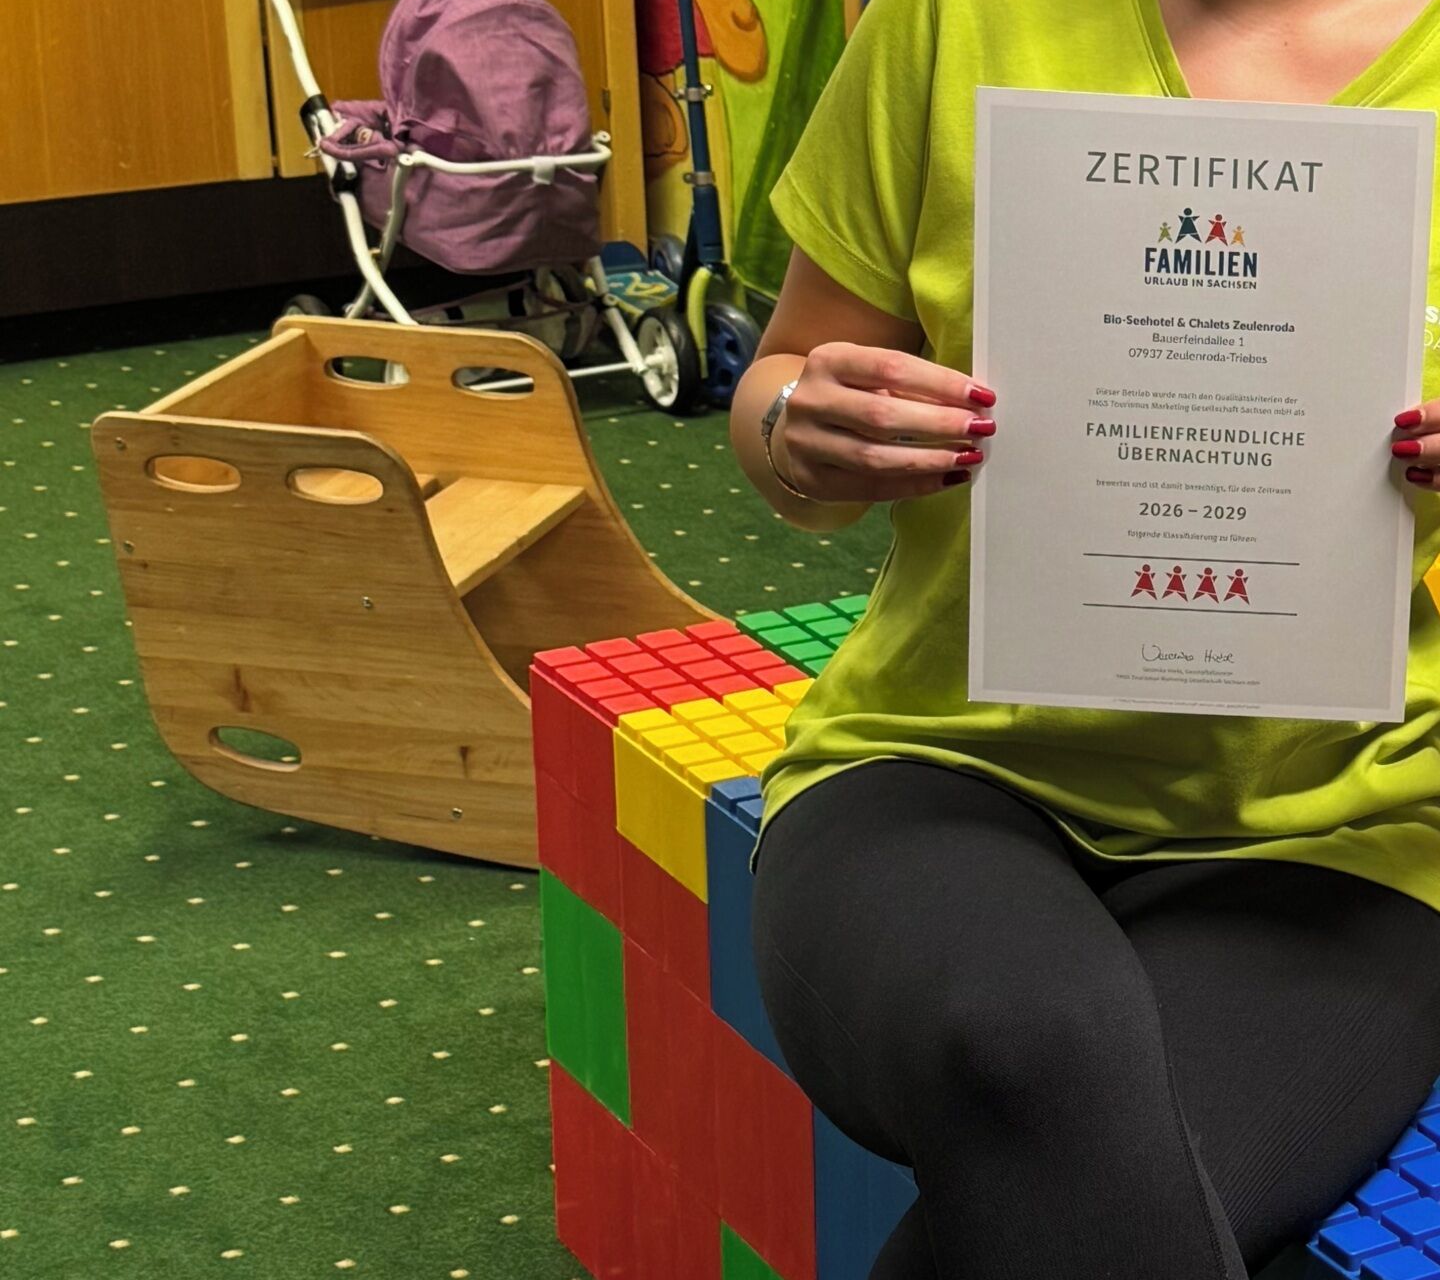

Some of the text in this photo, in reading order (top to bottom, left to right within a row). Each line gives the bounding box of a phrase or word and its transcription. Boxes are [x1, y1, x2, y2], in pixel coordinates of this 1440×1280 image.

[1085, 151, 1323, 193] ZERTIFIKAT
[1144, 247, 1258, 278] FAMILIEN
[1144, 276, 1258, 290] URLAUB IN SACHSEN
[1103, 313, 1296, 333] Bio-Seehotel & Chalets Zeulenroda
[1152, 332, 1245, 347] Bauerfeindallee 1
[1128, 347, 1269, 364] 07937 Zeulenroda-Triebes
[1151, 391, 1177, 399] wurde
[1284, 396, 1299, 405] der
[1150, 402, 1190, 413] Marketing
[1085, 422, 1306, 447] FAMILIENFREUNDLICHE
[1117, 442, 1273, 467] ÜBERNACHTUNG
[1228, 484, 1240, 493] für
[1241, 485, 1256, 493] den
[1138, 502, 1184, 518] 2026
[1202, 505, 1248, 521] 2029
